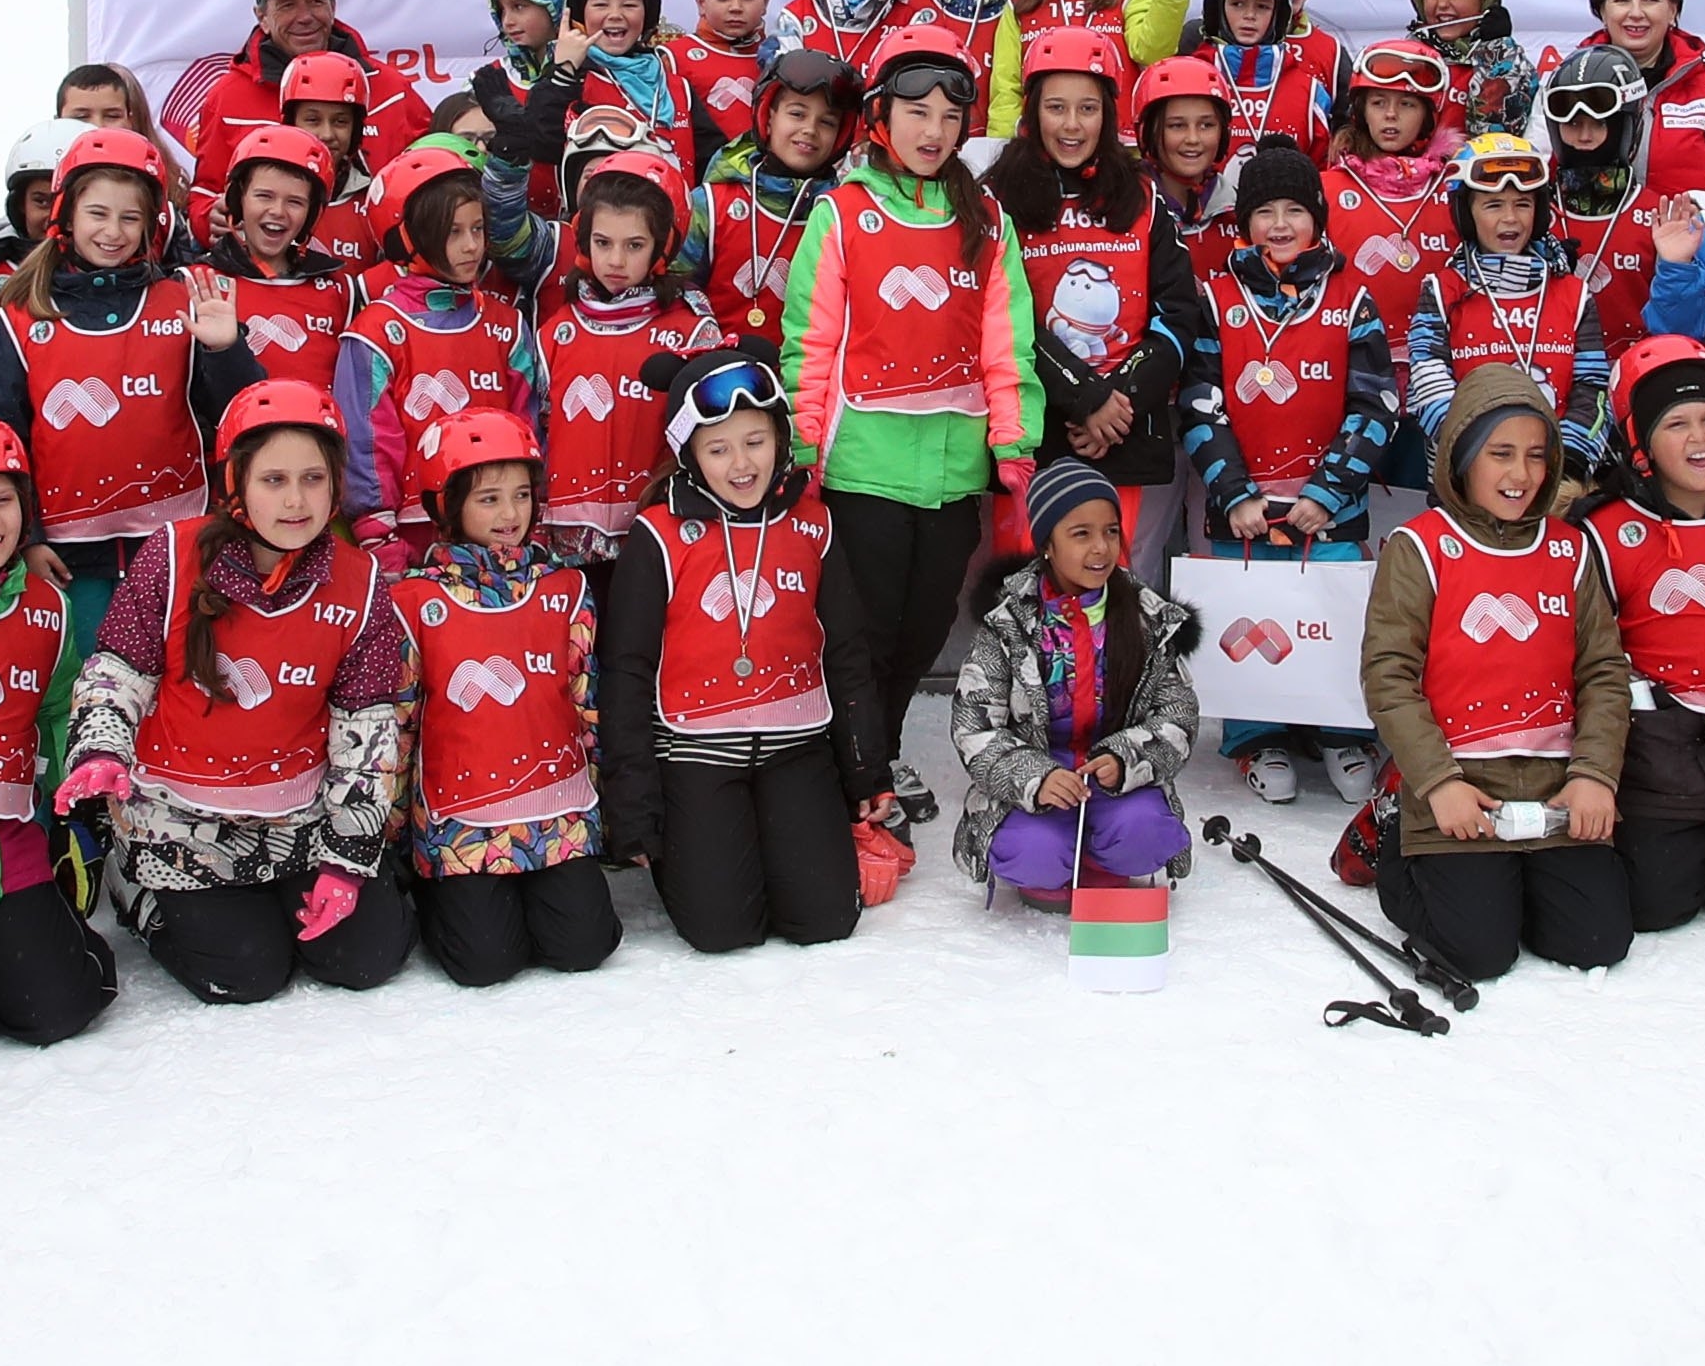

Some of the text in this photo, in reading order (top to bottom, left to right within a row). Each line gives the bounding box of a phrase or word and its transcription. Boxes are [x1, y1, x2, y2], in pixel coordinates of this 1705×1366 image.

[1048, 0, 1086, 18] 145
[374, 42, 452, 84] el
[1448, 86, 1468, 105] te
[1632, 208, 1653, 227] 85
[333, 237, 362, 260] tel
[1419, 231, 1450, 252] tel
[949, 266, 979, 290] tel
[142, 319, 184, 336] 1468
[305, 313, 334, 335] tel
[469, 369, 503, 392] tel
[1300, 360, 1332, 380] tel
[122, 373, 162, 397] tel
[1547, 539, 1577, 562] 88
[776, 567, 806, 593] tel
[313, 602, 357, 629] 1477
[540, 594, 569, 614] 147
[1538, 591, 1570, 617] tel
[23, 606, 60, 632] 1470
[1295, 619, 1333, 641] tel
[524, 650, 556, 675] tel
[9, 665, 41, 694] tel
[277, 662, 316, 687] tel
